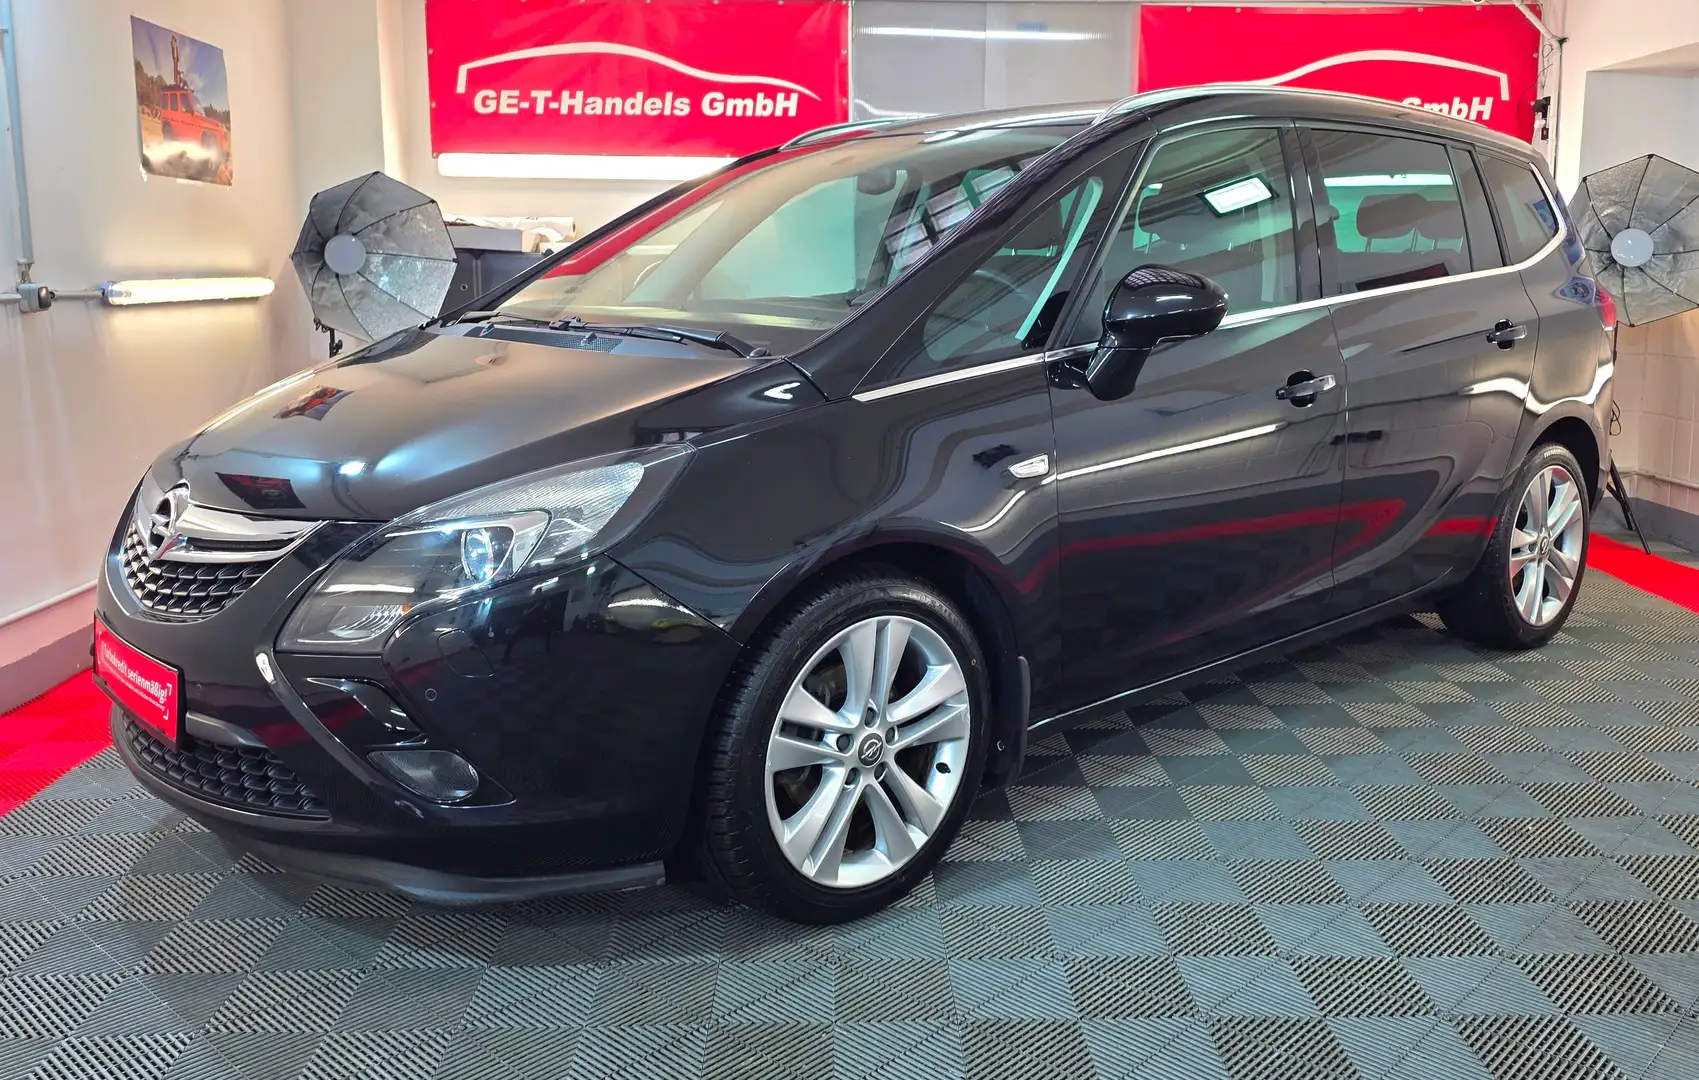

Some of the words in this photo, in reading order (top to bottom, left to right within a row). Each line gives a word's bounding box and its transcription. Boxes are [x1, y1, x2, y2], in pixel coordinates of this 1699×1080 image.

[473, 89, 691, 117] GE-T-Handels
[701, 91, 799, 117] GmbH
[127, 668, 168, 705] serienmäßig!
